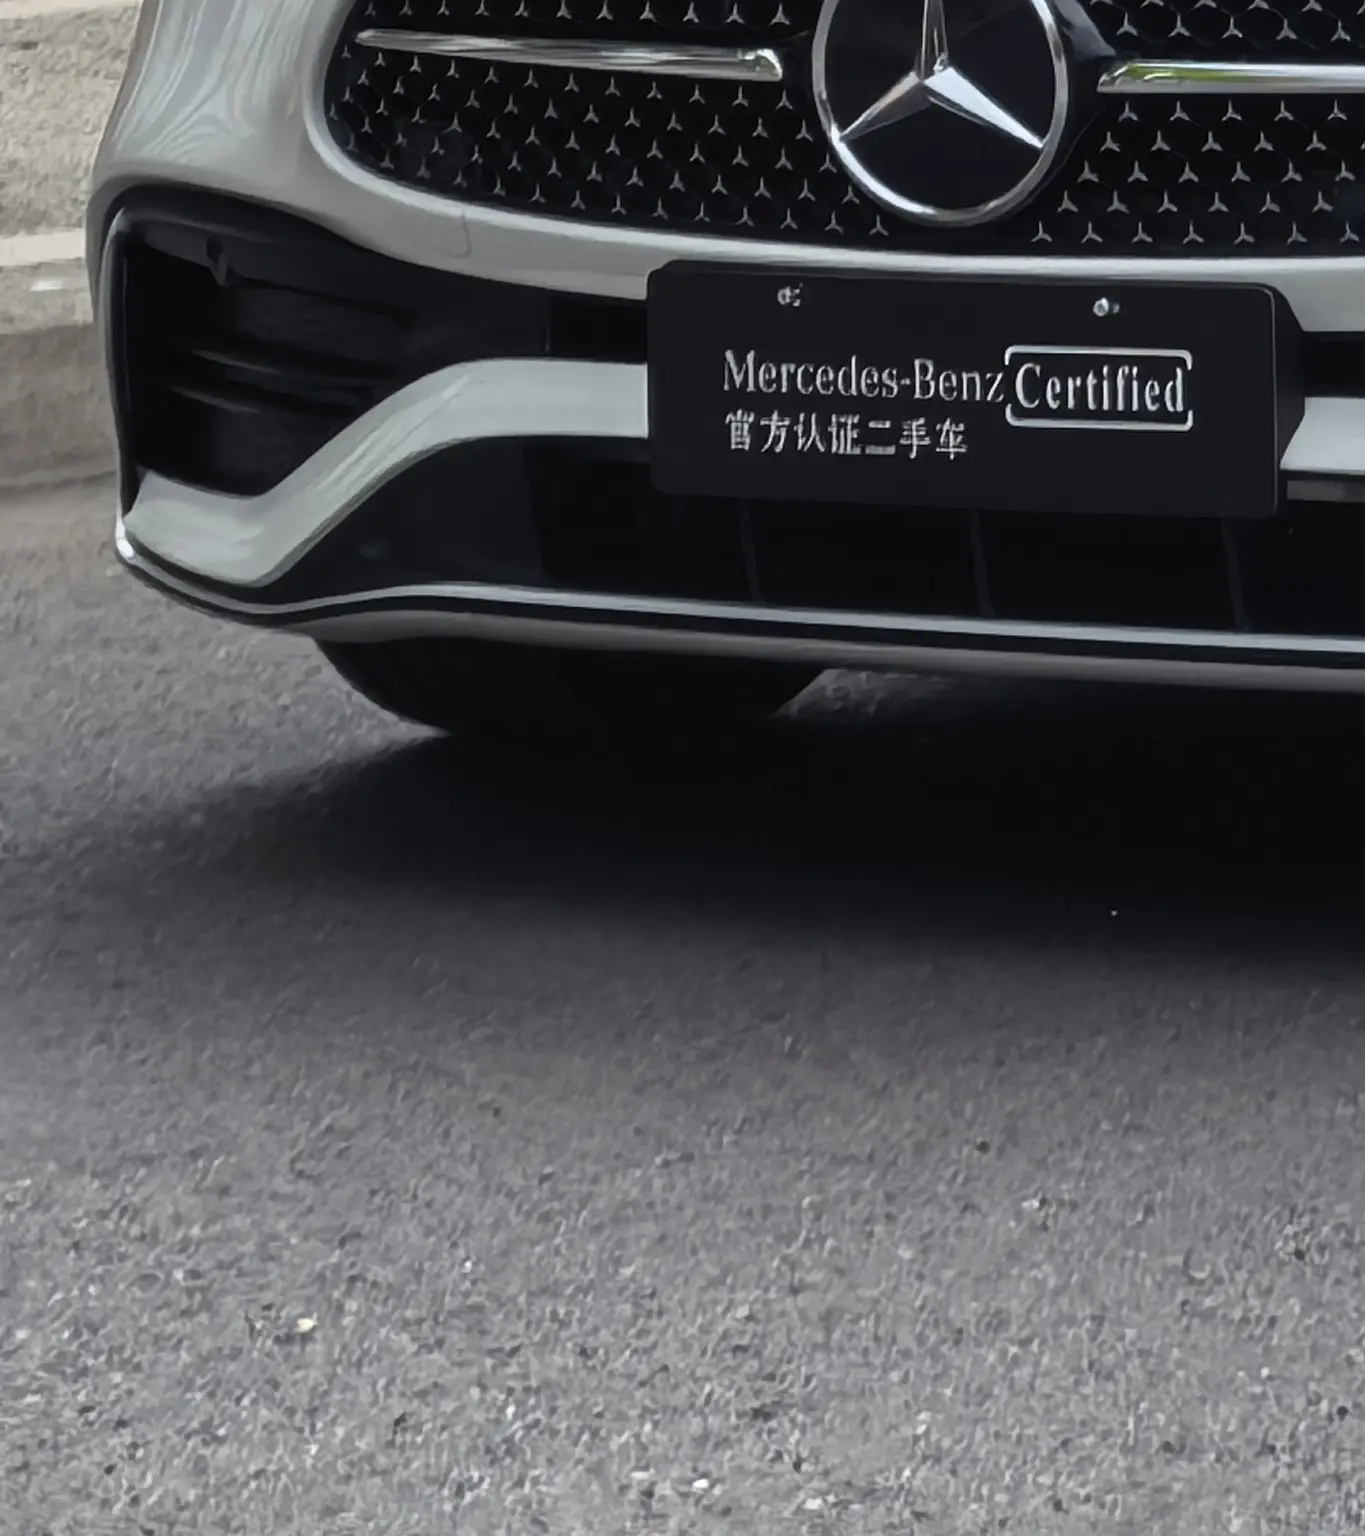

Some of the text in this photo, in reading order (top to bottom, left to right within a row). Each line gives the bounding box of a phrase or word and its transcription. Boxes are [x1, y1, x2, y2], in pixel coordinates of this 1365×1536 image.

[724, 350, 1187, 412] Mercedes-Benz Certified
[725, 409, 966, 460] 官方认证二手车
